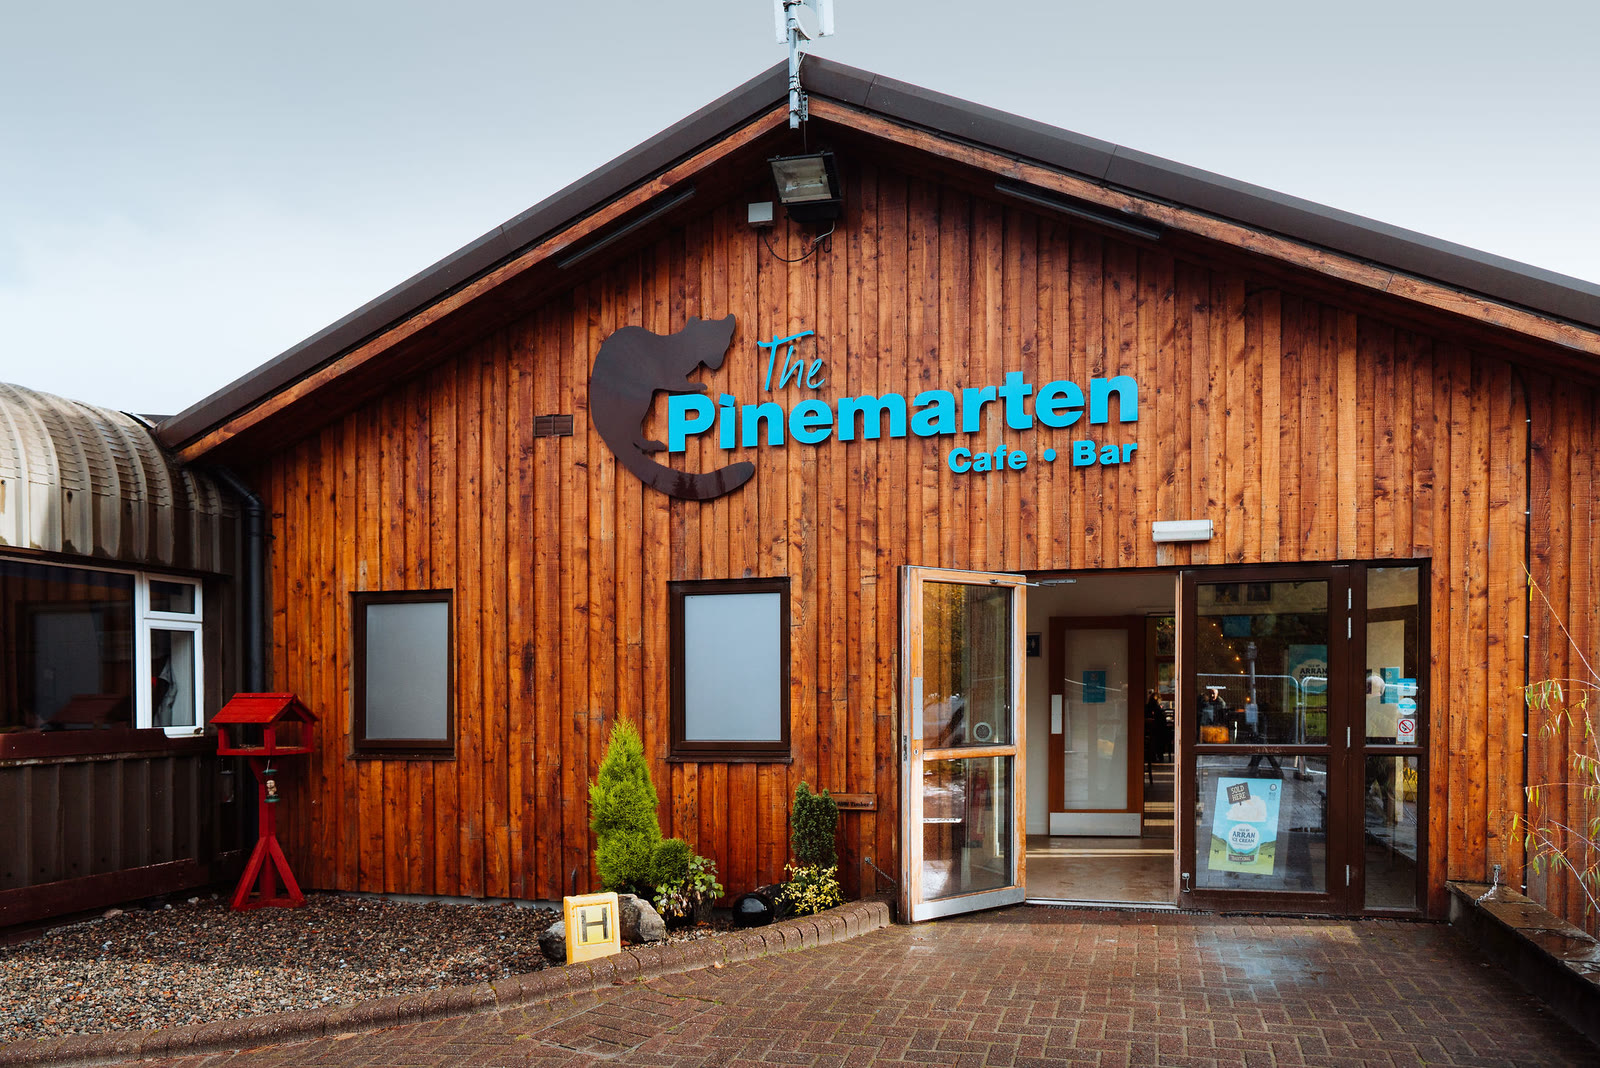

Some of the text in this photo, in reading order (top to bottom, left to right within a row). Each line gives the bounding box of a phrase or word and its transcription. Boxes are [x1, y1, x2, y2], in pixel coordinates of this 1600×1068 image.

[757, 330, 825, 392] The
[668, 370, 1139, 453] Pinemarten
[948, 439, 1138, 473] Cafe Bar
[1231, 785, 1244, 794] SOLD
[1232, 792, 1246, 801] HERE
[580, 908, 608, 942] H
